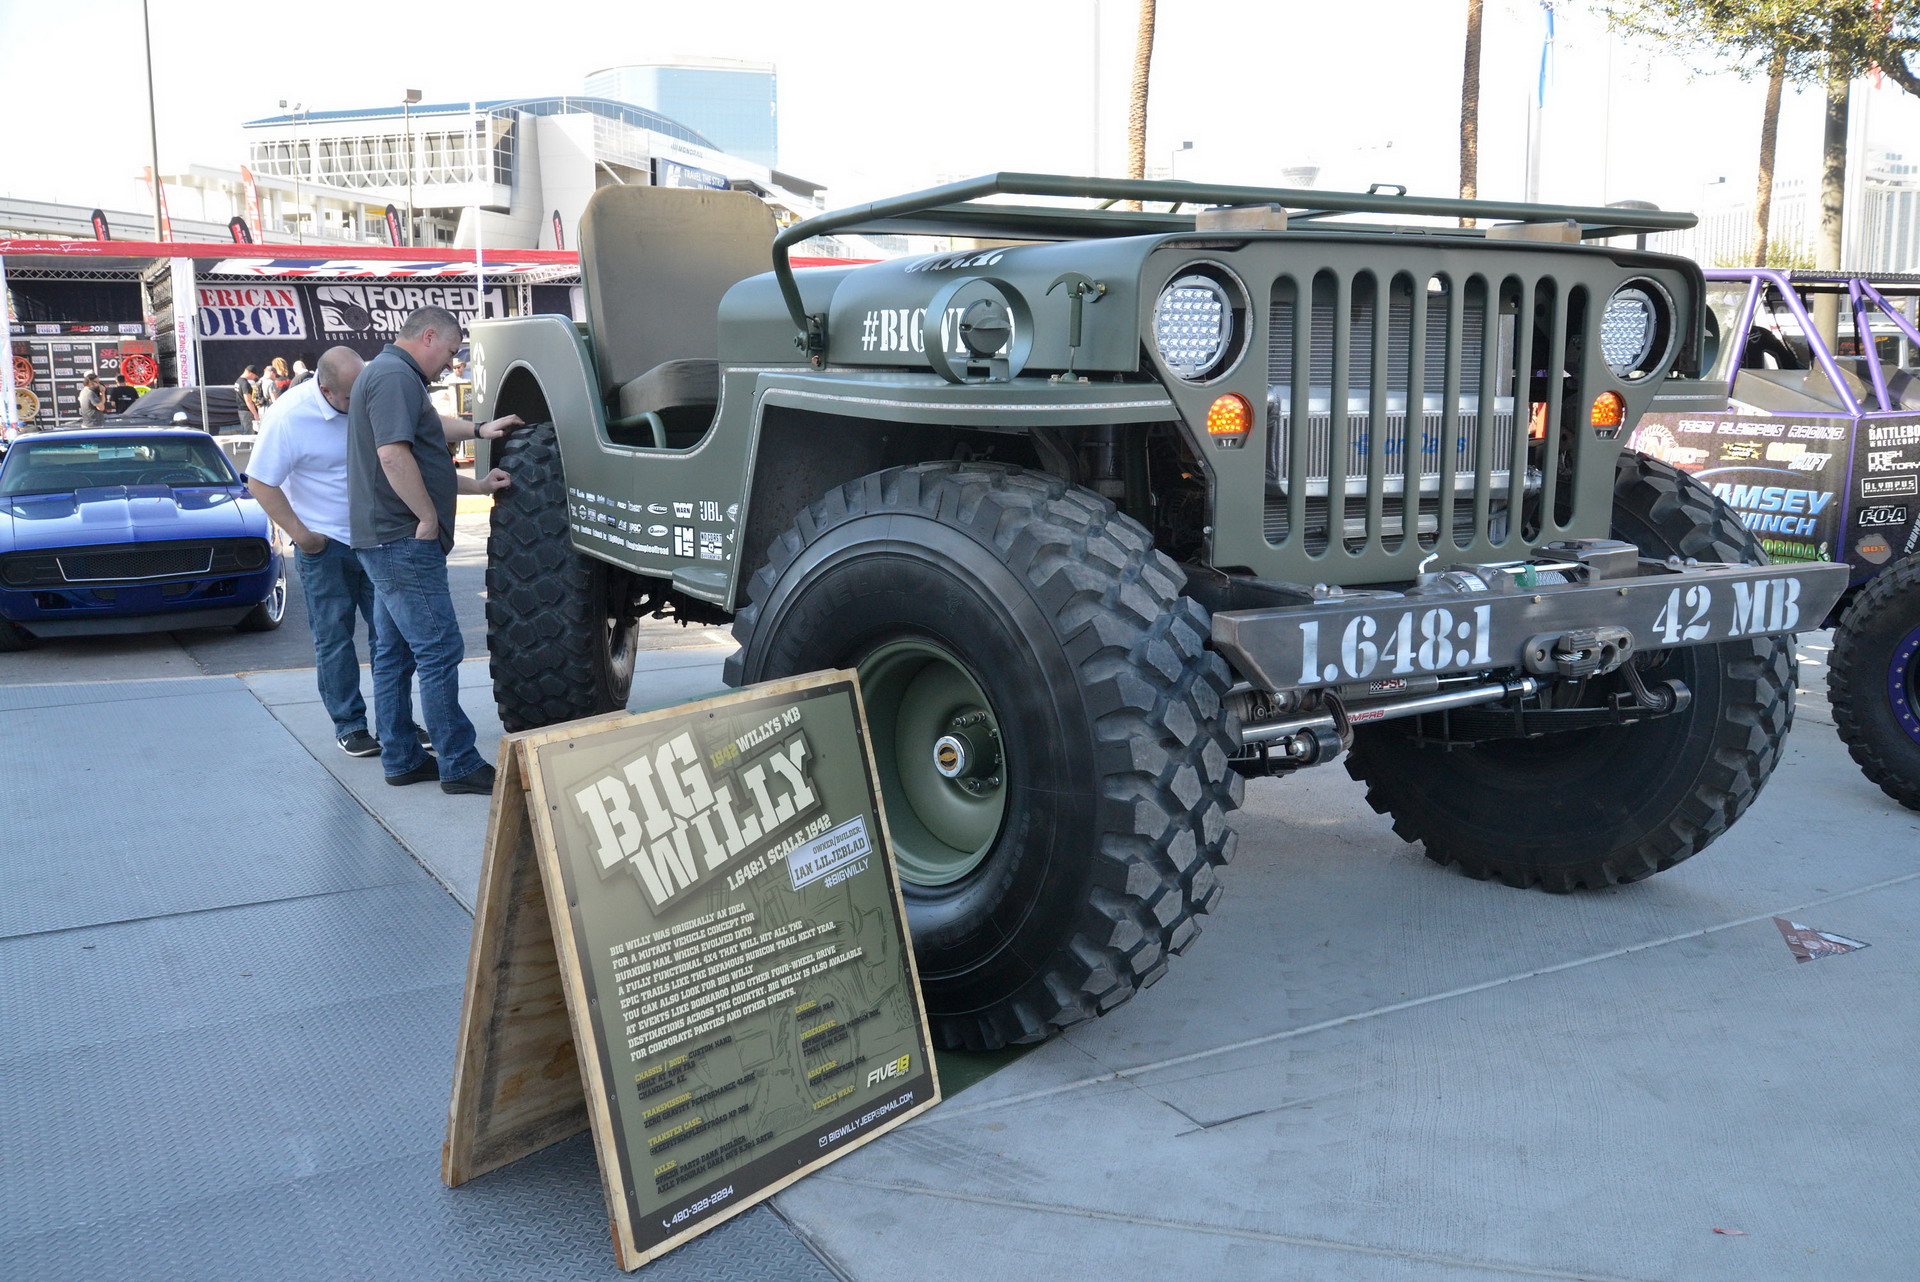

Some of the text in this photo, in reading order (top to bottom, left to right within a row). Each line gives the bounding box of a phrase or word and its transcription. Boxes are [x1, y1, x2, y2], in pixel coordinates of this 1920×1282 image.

[684, 168, 725, 188] TRAVEL THE STRIP
[198, 289, 301, 336] ERICAN ORCE
[365, 286, 479, 310] FORGED
[371, 309, 413, 333] SIN
[1788, 424, 1845, 441] RACING
[1701, 482, 1833, 515] AMSEY
[1864, 480, 1915, 490] OLYMPUS
[1759, 539, 1815, 558] ORIDA
[1652, 577, 1801, 643] 42 MB
[1298, 605, 1492, 684] 1.648:1
[709, 706, 801, 768] 1942 WILLYS MB
[575, 731, 714, 870] BIG
[628, 739, 816, 906] WILLY
[813, 825, 862, 854] OWNER/BUILDER:
[726, 814, 832, 891] 1.648:1 SCALE 1942
[794, 837, 865, 880] IAN LILJEBLAD
[825, 858, 869, 888] #BIGWILLY
[610, 902, 746, 956] BIG WILLY WAS ORIGINALLY AN IDEA
[612, 912, 755, 970] FOR A MUTANT VEHICLE CONCEPT FOR
[614, 926, 752, 983] BURNING MAN. WHICH EVOLVED INTO
[618, 920, 803, 996] A FULLY FUNCTIONAL 4X4 THAT WILL HIT ALL THE
[620, 921, 836, 1009] EPIC TRAILS LIKE THE INFAMOUS RUBICON TRAIL NEXT YEAR.
[622, 964, 753, 1022] YOU CAN ALSO LOOK FOR BIG WILLY
[626, 945, 836, 1035] AT EVENTS LIKE BONNAROO AND OTHER FOUR-WHEEL DRIVE
[627, 947, 863, 1049] DESTINATIONS ACROSS THE COUNTRY. BIG WILLY IS ALSO AVAILABLE
[630, 987, 797, 1062] FOR CORPORATE PARTIES AND OTHER EVENTS.
[635, 1065, 663, 1082] CHASSIS
[668, 1054, 688, 1067] BODY:
[688, 1042, 714, 1059] CUSTOM
[636, 1076, 657, 1091] BUILT
[658, 1071, 667, 1082] AT
[867, 1054, 910, 1088] FIVE18
[642, 1091, 693, 1119] TRANSMISSION:
[643, 1115, 661, 1129] ZERO
[662, 1101, 690, 1120] GRAVITY
[691, 1080, 736, 1107] PERFORMANCE
[828, 1091, 913, 1143] BIGWILLYJEEP@GMAIL.COM
[647, 1117, 703, 1146] TRANSFER CASE:
[720, 1135, 747, 1155] BUILDER
[654, 1160, 678, 1176] AXLES:
[657, 1180, 675, 1194] AXLE
[676, 1167, 706, 1188] PROGRAM
[672, 1185, 733, 1224] 480-329-2294
